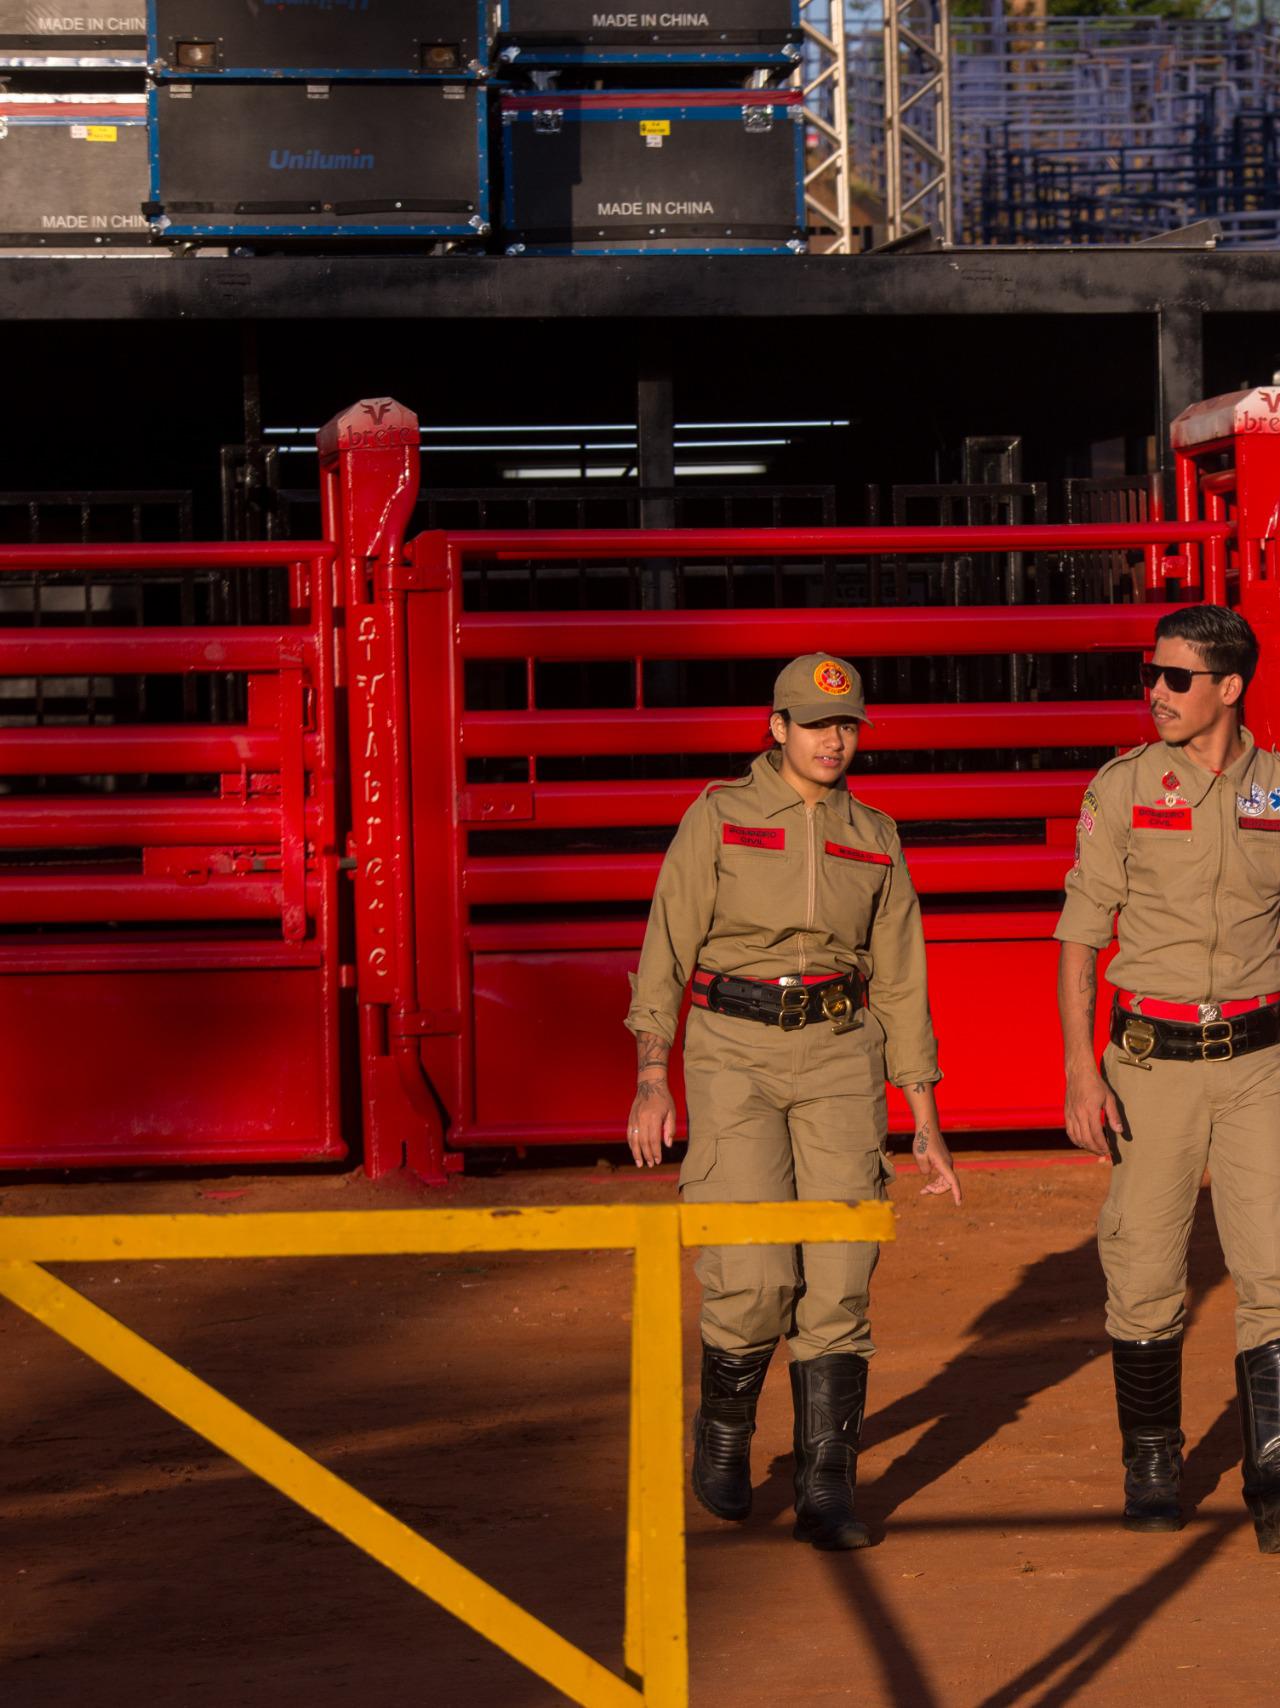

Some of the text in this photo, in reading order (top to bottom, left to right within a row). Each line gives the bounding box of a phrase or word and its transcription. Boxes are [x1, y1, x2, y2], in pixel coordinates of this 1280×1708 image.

[39, 17, 147, 31] MADE IN CHIN
[592, 13, 709, 27] MADE IN CHINA
[269, 148, 375, 169] Unilumin
[597, 201, 714, 216] MADE IN CHINA
[42, 215, 150, 228] MADE IN CHIN
[347, 424, 411, 446] brete
